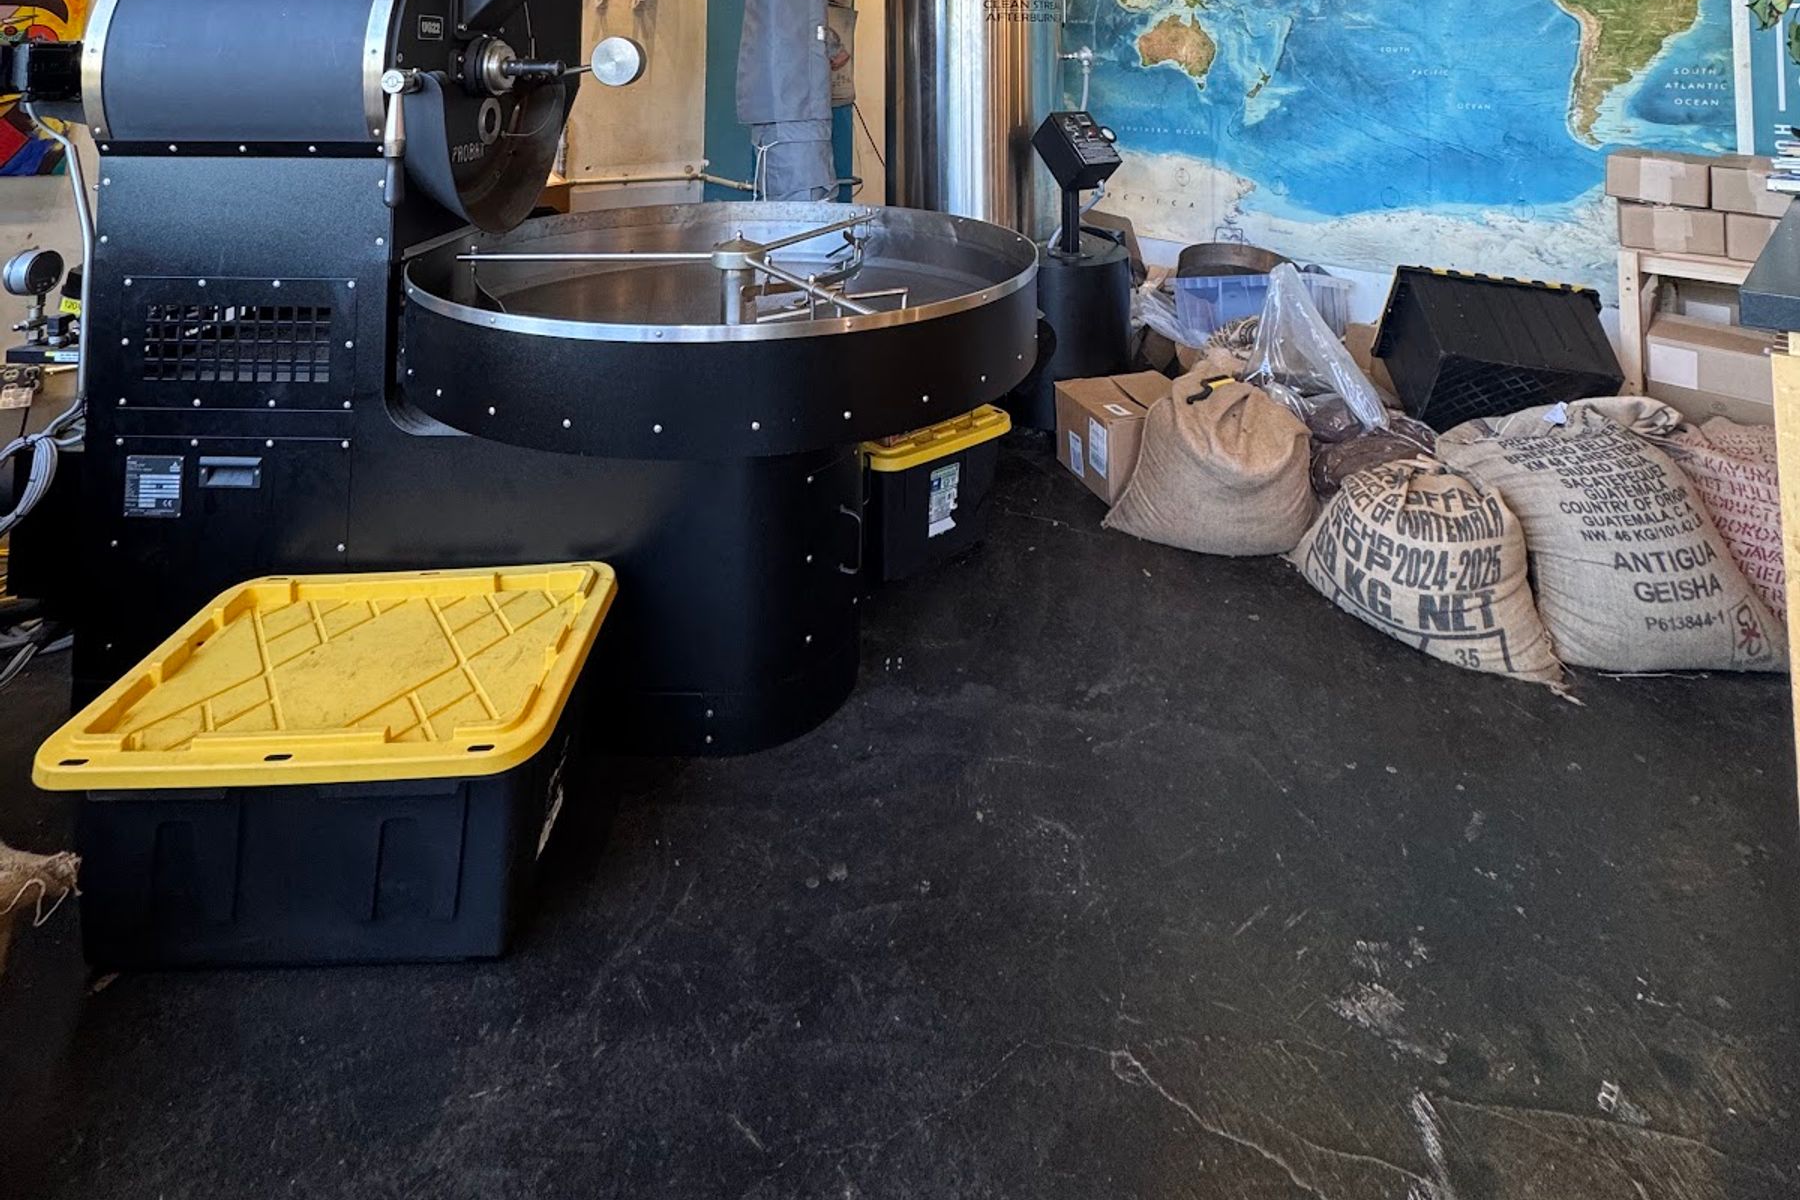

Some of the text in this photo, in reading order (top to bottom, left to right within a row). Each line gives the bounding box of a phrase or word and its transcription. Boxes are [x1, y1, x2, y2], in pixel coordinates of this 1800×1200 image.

[983, 0, 1030, 10] CLEAN
[1673, 68, 1718, 76] SOUTH
[1664, 81, 1728, 91] ATLANTIC
[1674, 98, 1720, 107] OCEAN
[1523, 459, 1550, 473] KM
[1556, 453, 1651, 477] CIUDAD VIEJA
[1560, 464, 1667, 490] SACATEPEQUEZ
[1583, 478, 1669, 501] GUATEMALA
[1371, 502, 1395, 527] OF
[1559, 499, 1630, 515] COUNTRY
[1632, 496, 1653, 512] OF
[1391, 543, 1503, 592] 2024-2025
[1612, 538, 1718, 574] ANTIGUA
[1633, 572, 1724, 604] GEISHA
[1418, 588, 1497, 633] NET
[1644, 609, 1725, 633] P613844-1
[1453, 647, 1481, 669] 35
